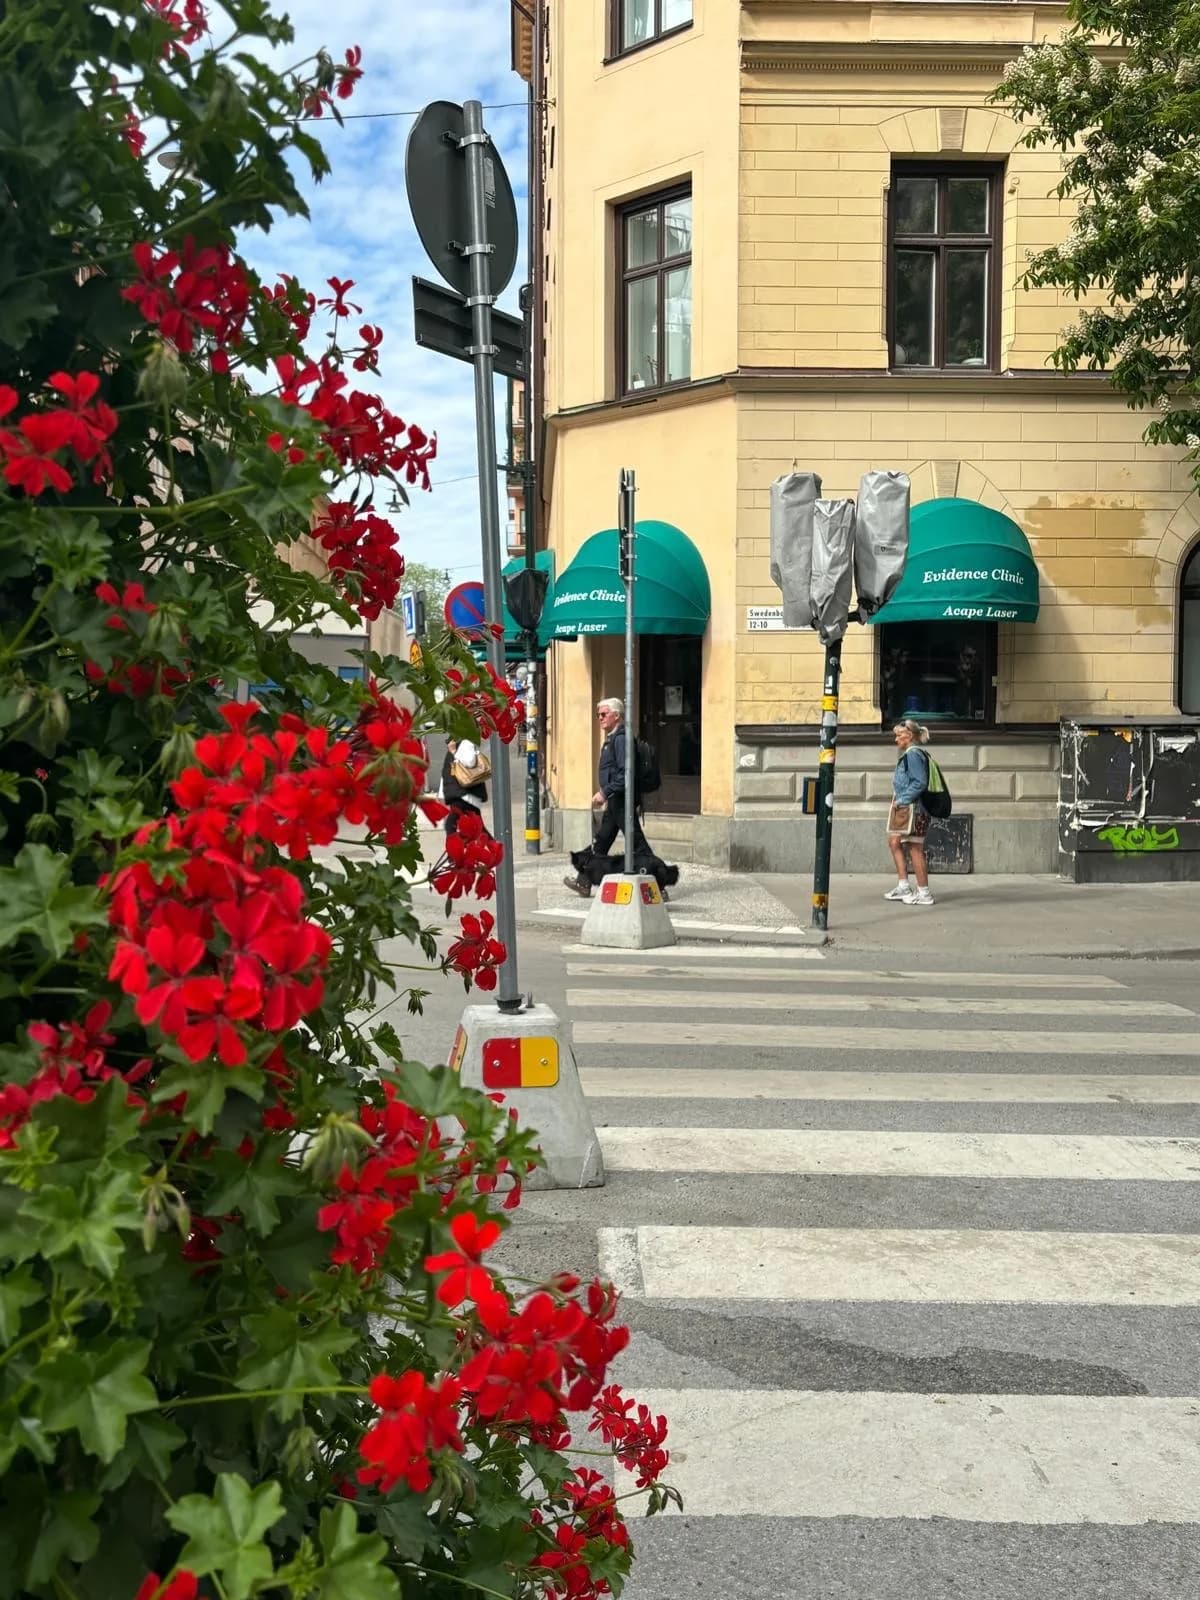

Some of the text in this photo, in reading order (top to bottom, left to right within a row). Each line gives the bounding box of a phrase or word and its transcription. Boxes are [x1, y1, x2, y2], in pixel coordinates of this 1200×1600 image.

[922, 568, 1024, 585] Evidence Clinic
[589, 589, 626, 603] Clinic
[942, 604, 1018, 618] Acape Laser
[577, 622, 607, 632] Laser
[749, 621, 768, 629] 12-10
